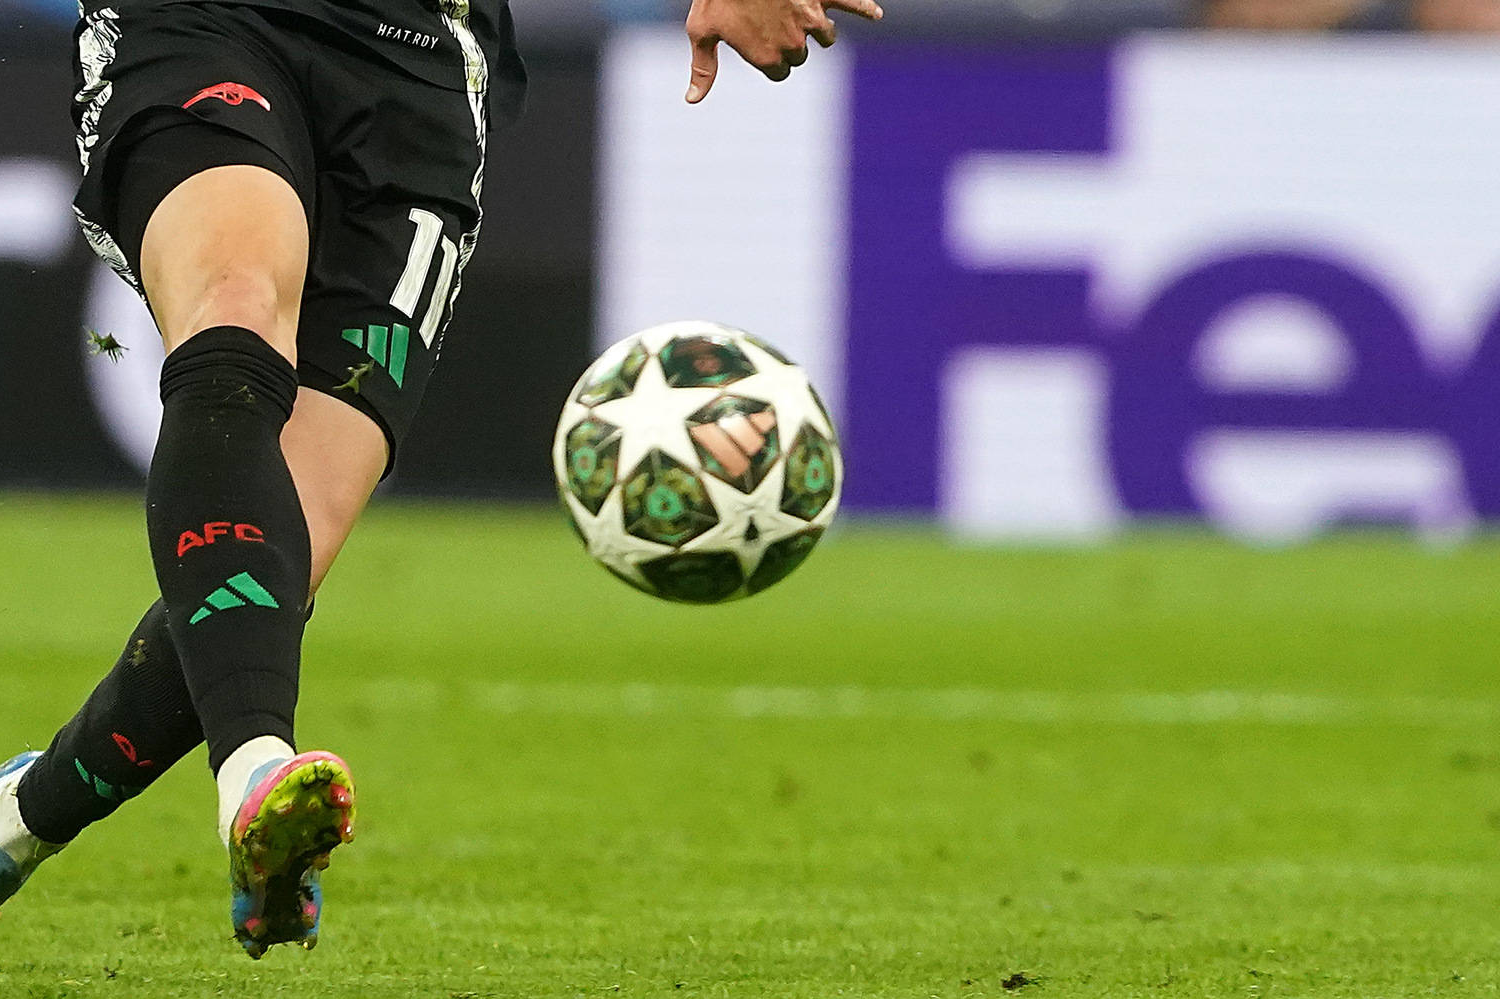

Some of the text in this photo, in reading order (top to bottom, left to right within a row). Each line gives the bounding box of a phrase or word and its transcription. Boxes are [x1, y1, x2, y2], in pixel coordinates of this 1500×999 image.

[389, 208, 458, 350] 11
[850, 40, 1500, 518] Fe
[177, 521, 265, 557] AFC
